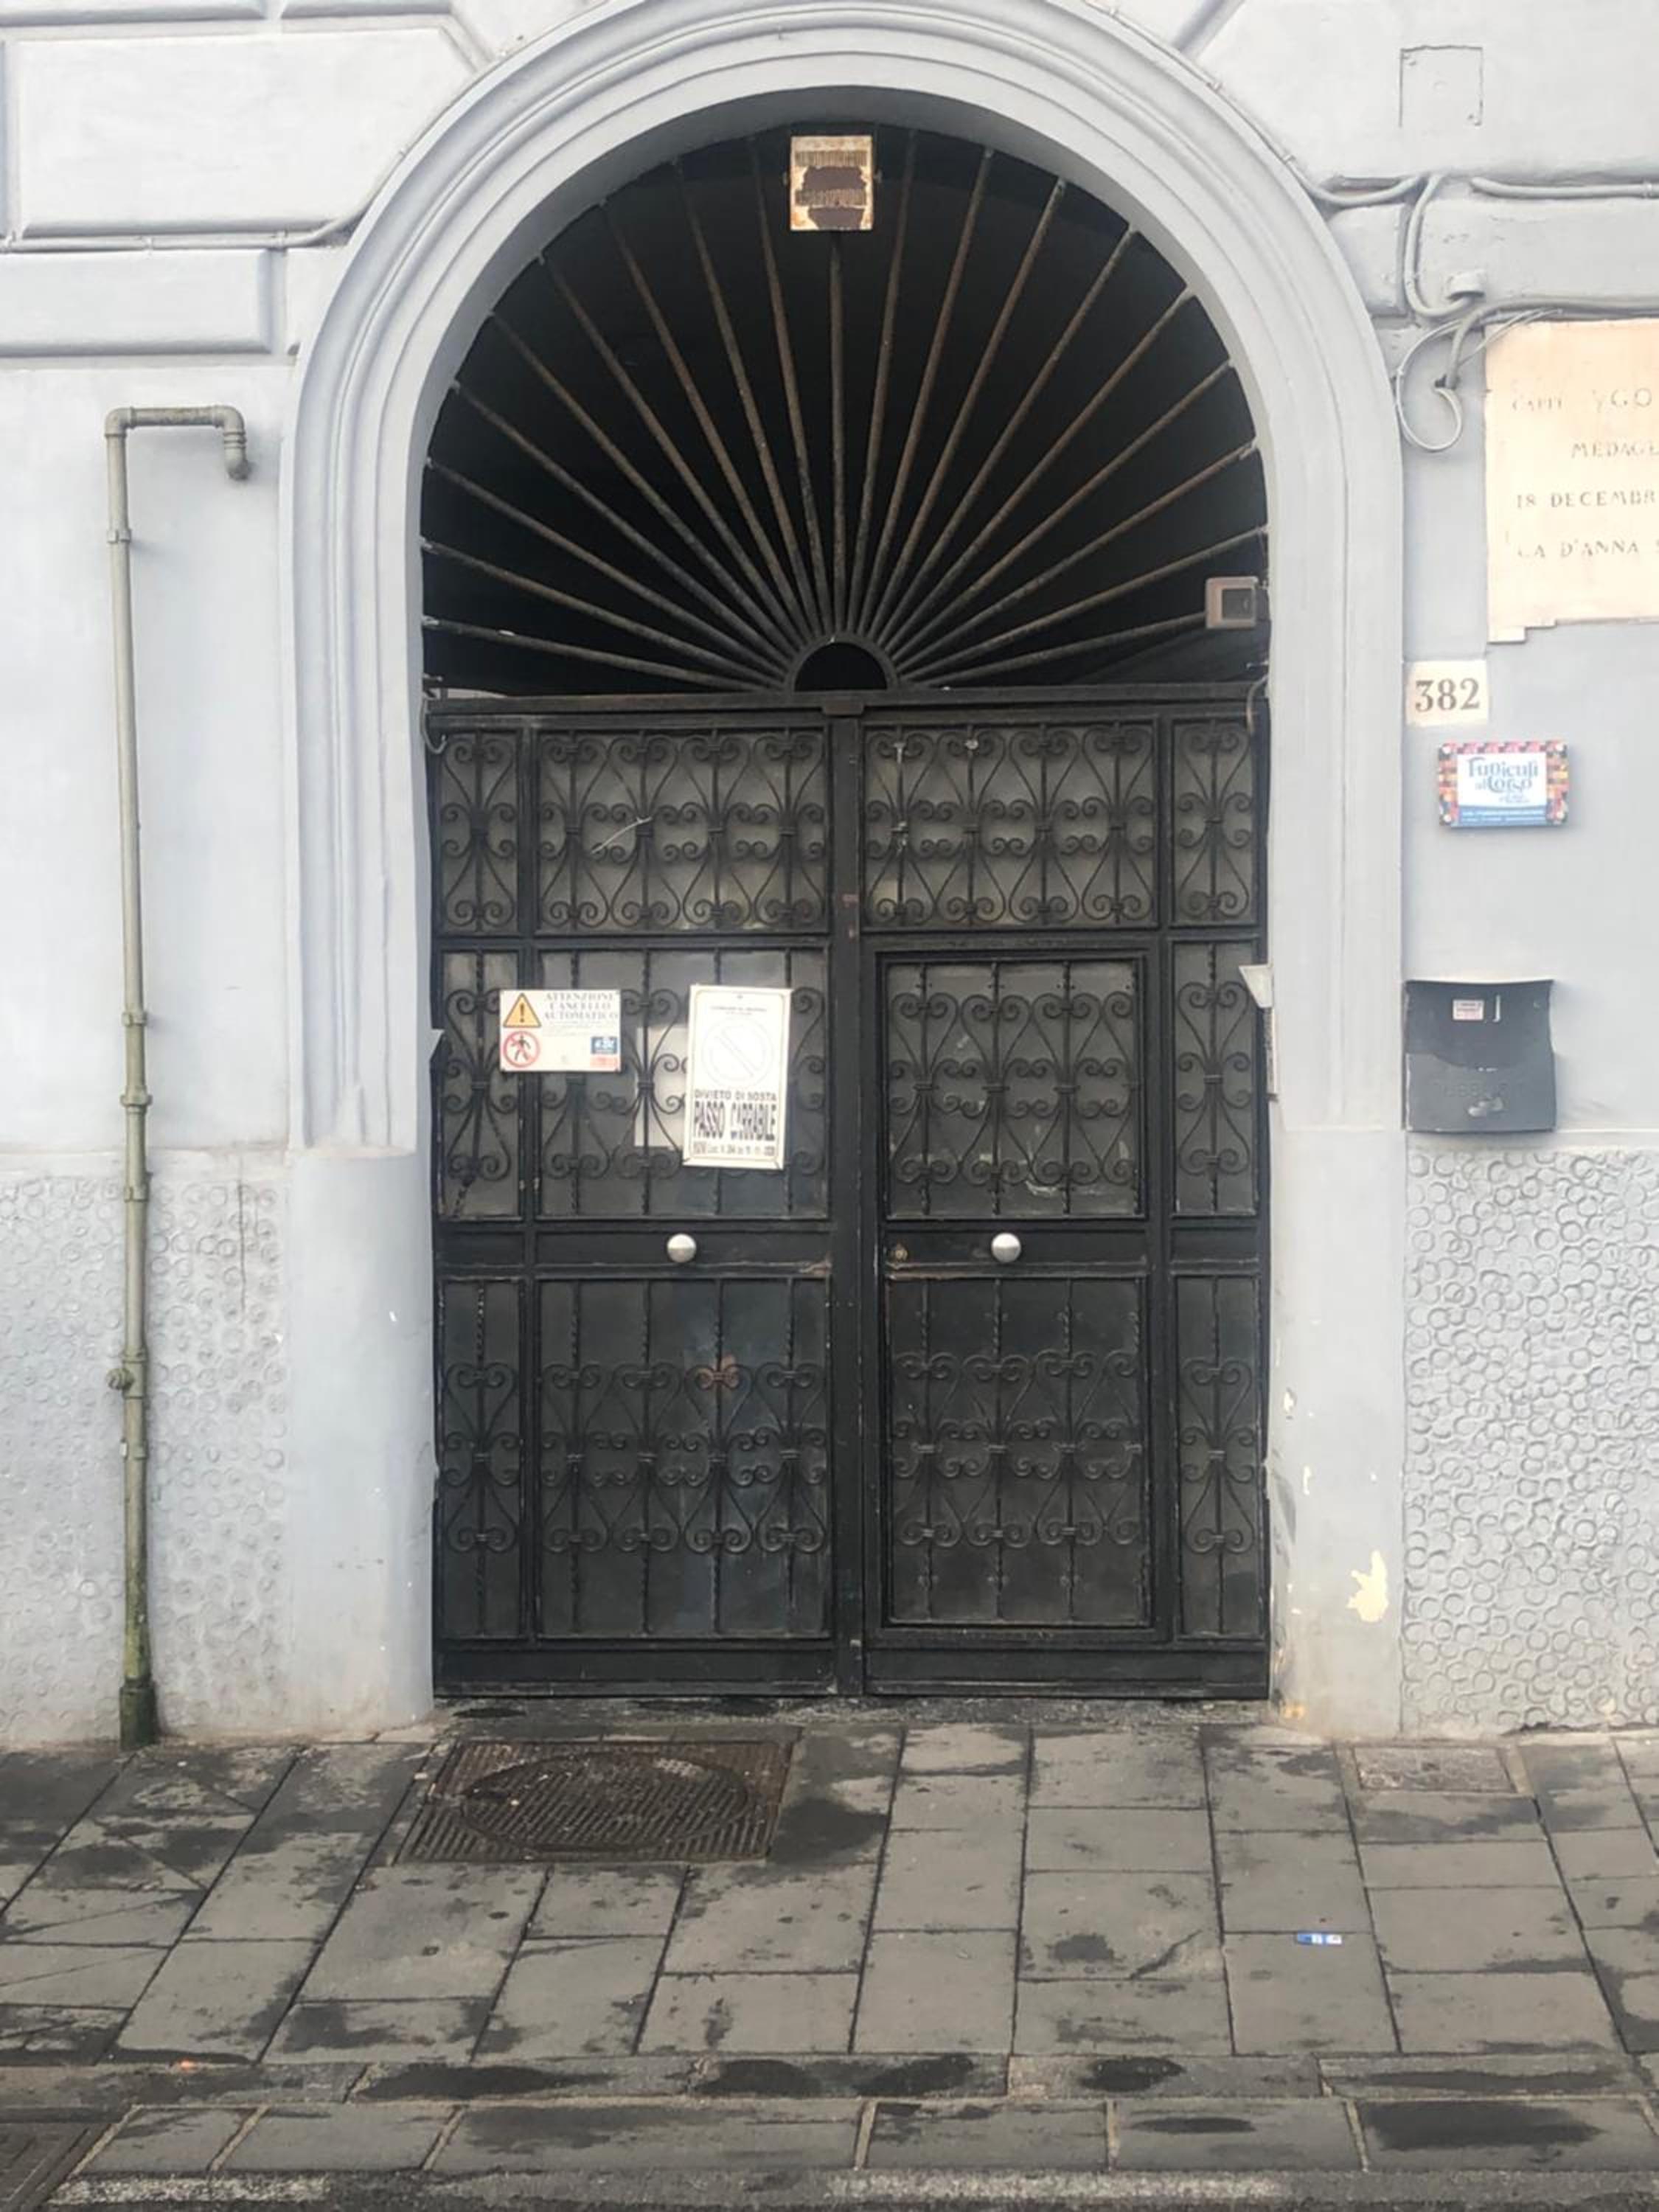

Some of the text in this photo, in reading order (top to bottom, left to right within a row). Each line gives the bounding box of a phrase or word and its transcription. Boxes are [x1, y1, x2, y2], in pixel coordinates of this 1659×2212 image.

[1517, 493, 1537, 509] 18
[1415, 678, 1481, 712] 382
[549, 1002, 612, 1010] CANCELLO
[544, 1011, 619, 1020] AUTOMATICO
[695, 1089, 777, 1102] DIVIETO DI SOSTA
[693, 1101, 726, 1139] PASSO
